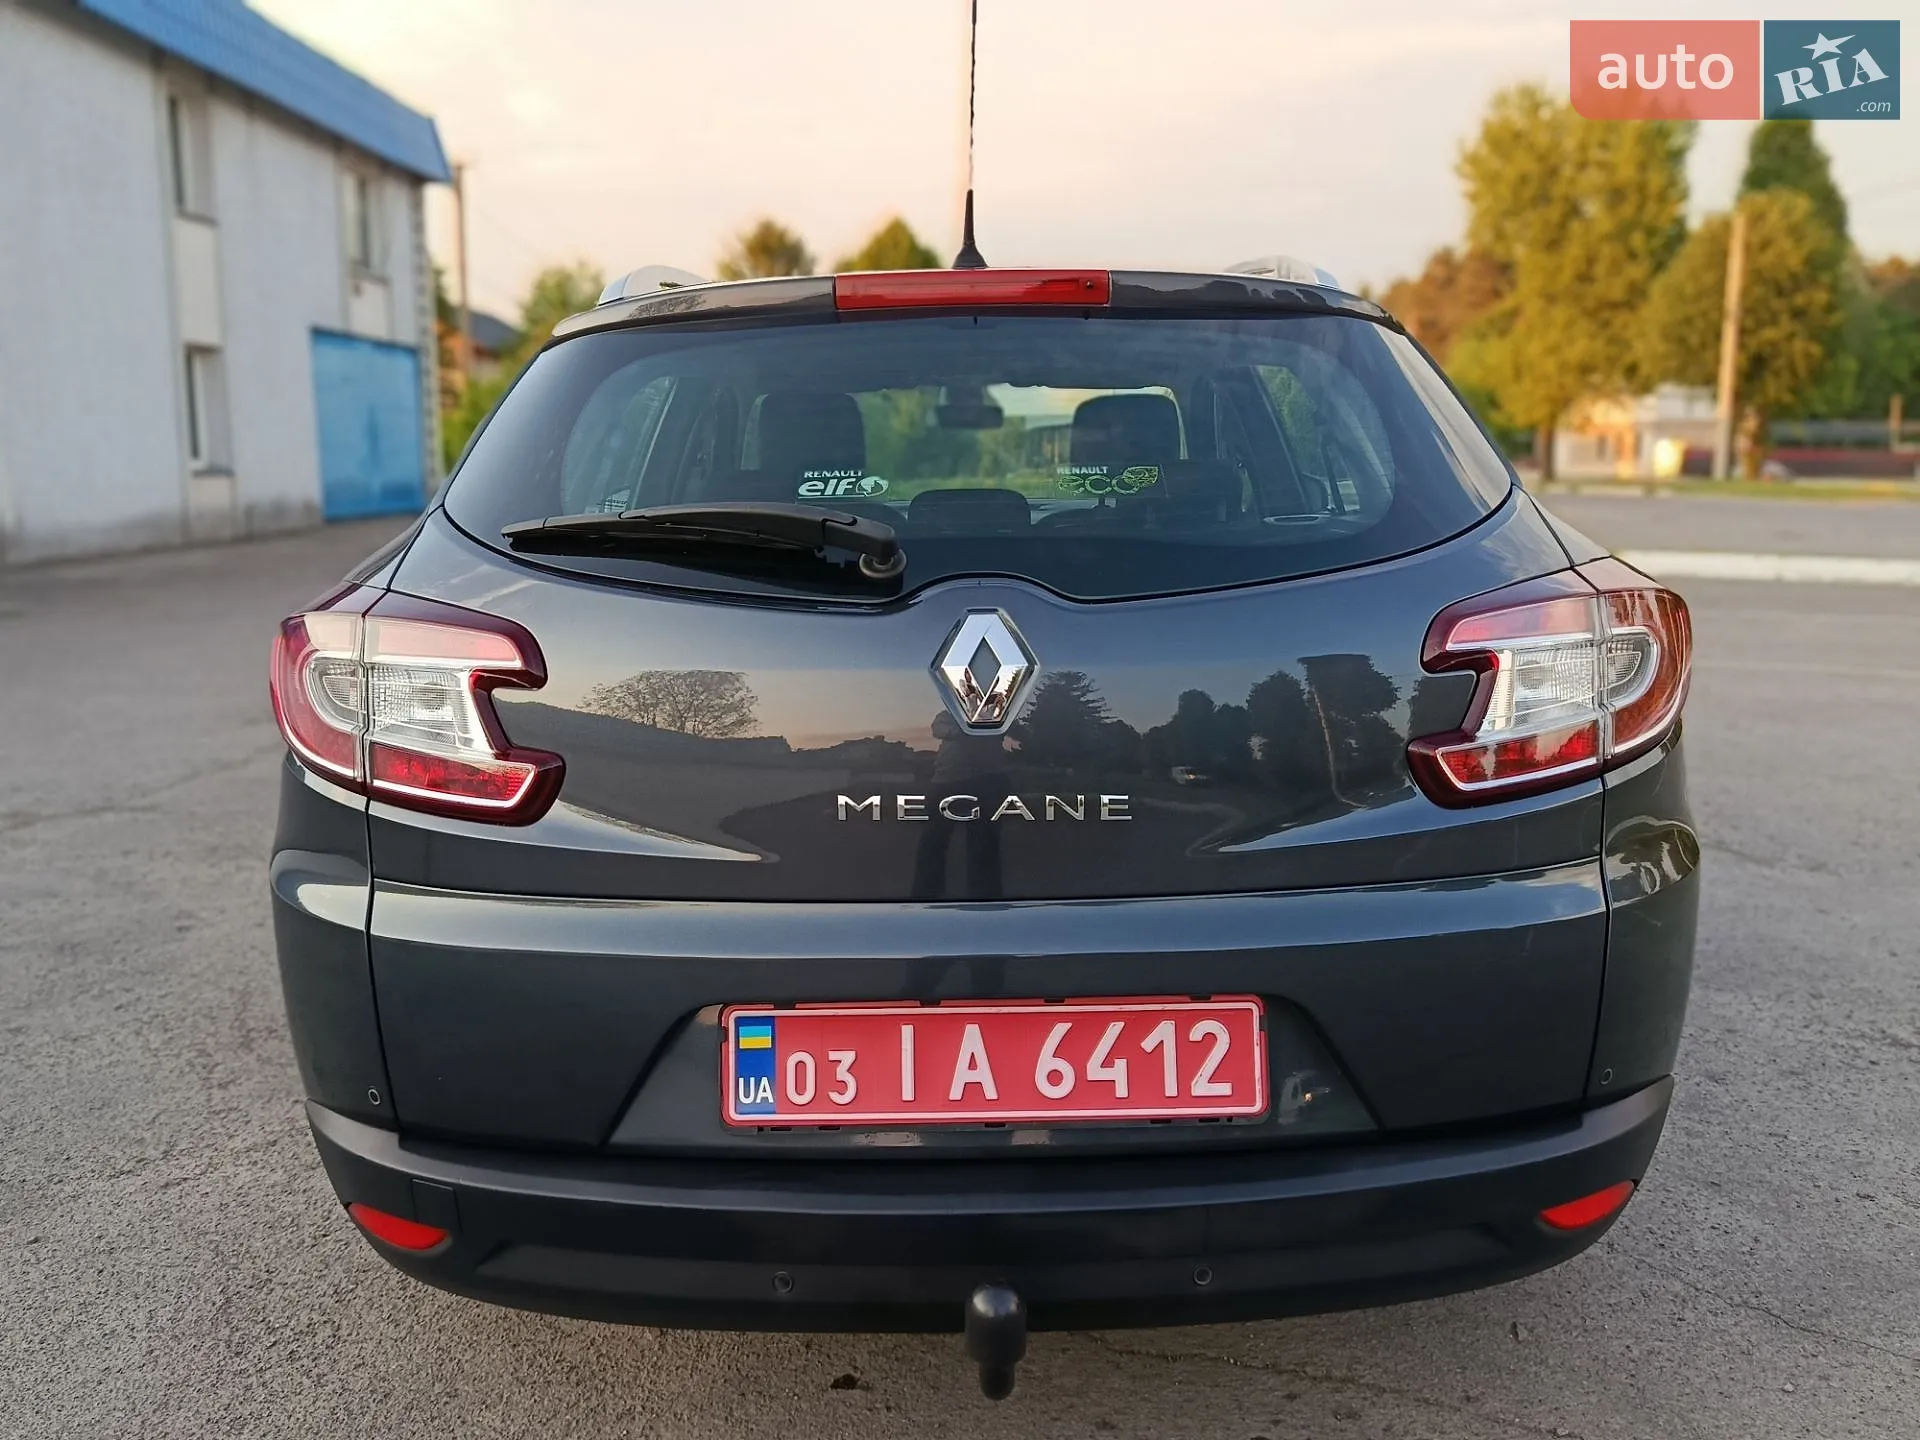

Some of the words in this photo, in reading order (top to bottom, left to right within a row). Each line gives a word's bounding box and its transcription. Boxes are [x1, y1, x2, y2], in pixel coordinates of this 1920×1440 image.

[1057, 466, 1108, 475] RENAULT
[798, 478, 856, 496] elf
[837, 795, 1132, 821] MEGANE
[785, 1049, 857, 1106] 03
[1034, 1020, 1232, 1099] 6412
[738, 1077, 774, 1104] UA
